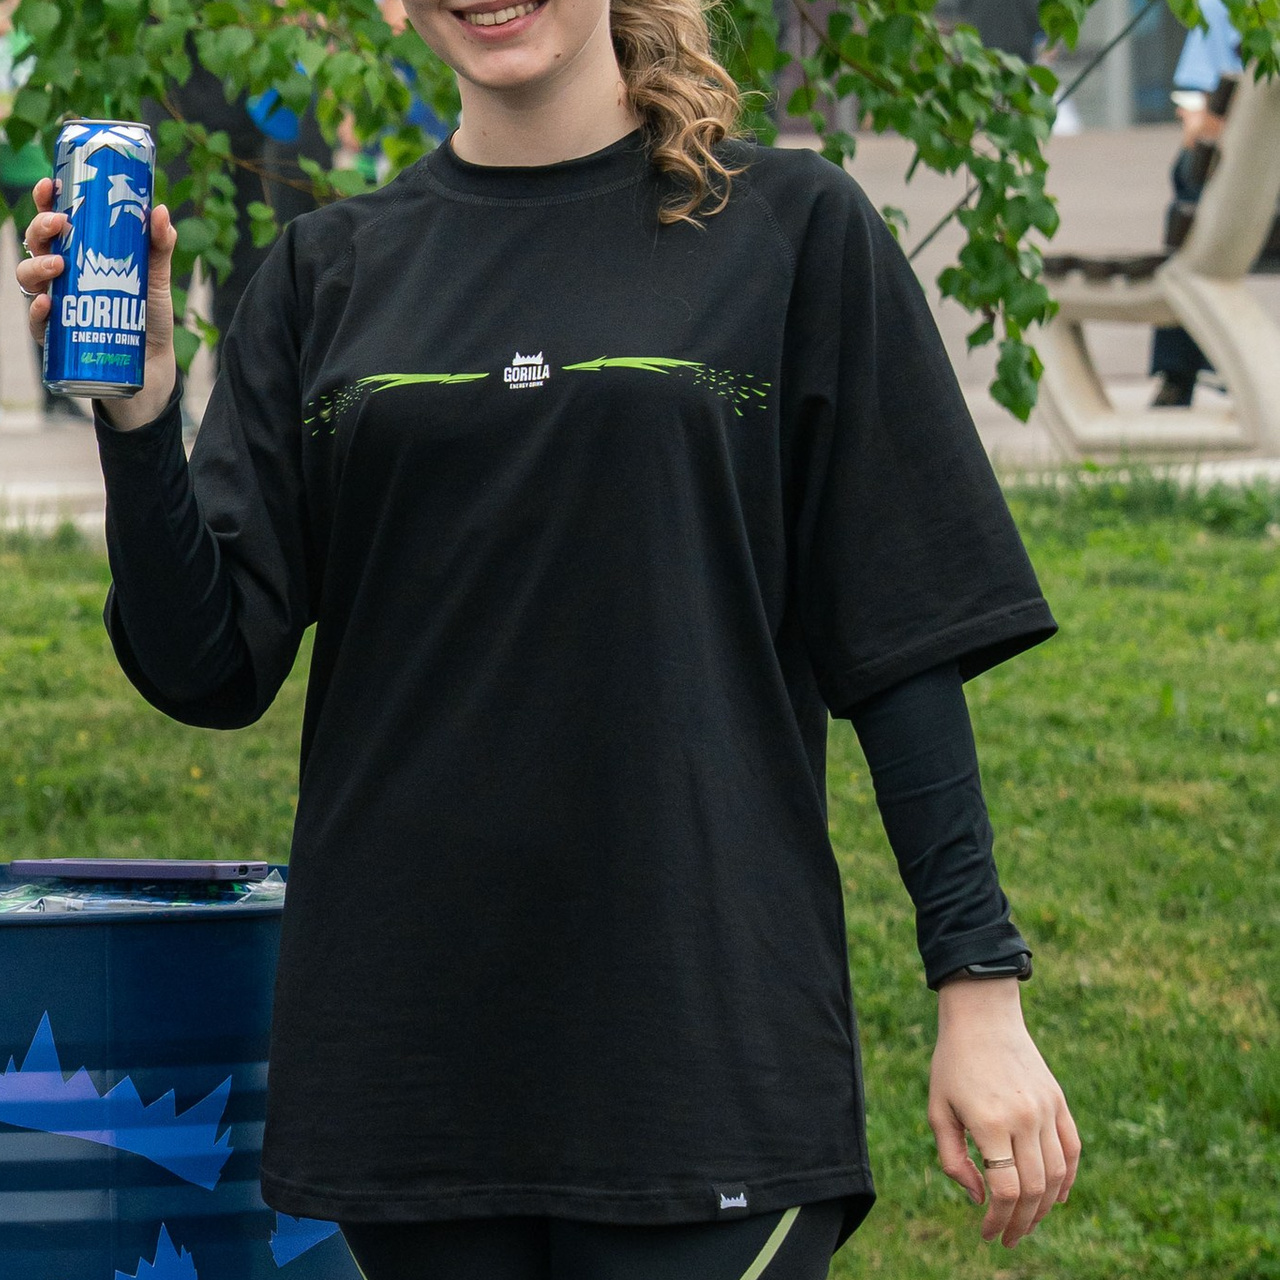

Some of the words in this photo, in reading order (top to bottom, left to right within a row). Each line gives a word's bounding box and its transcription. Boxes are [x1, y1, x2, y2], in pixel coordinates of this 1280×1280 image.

[61, 295, 146, 331] GORILLA
[72, 331, 113, 343] ENERGY
[115, 333, 140, 346] DRINK
[81, 352, 131, 366] ULTIMATE
[503, 364, 550, 382] GORILLA
